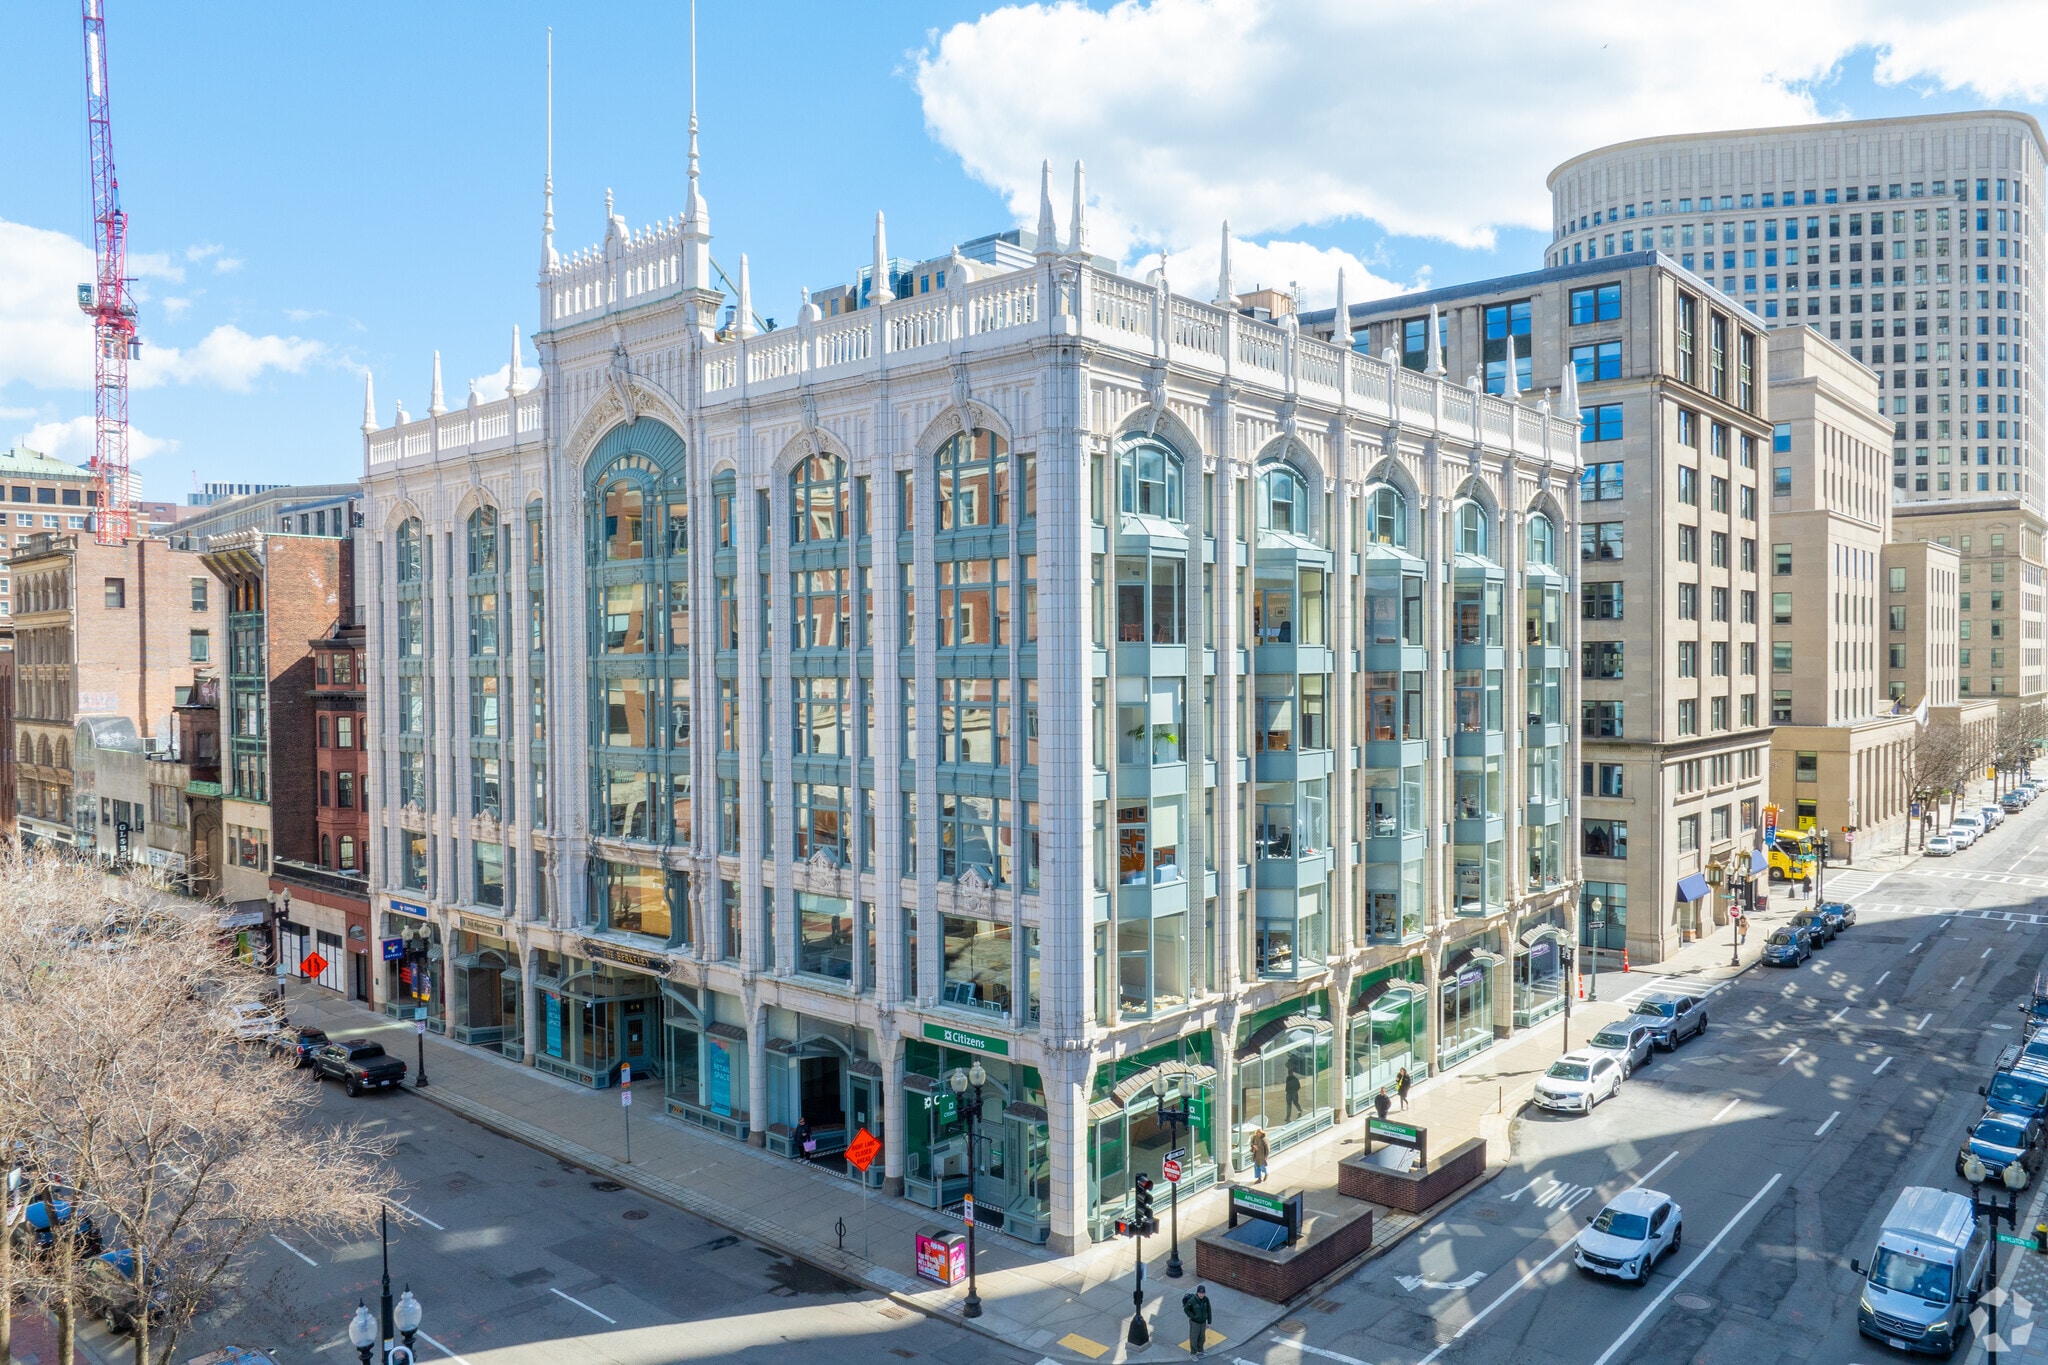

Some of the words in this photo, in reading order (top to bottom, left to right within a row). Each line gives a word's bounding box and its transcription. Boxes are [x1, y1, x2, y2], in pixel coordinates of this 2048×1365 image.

[602, 948, 614, 959] THE
[616, 951, 650, 967] BERKELEY
[952, 1032, 985, 1049] Citizens
[713, 1063, 730, 1074] RETAIL
[714, 1071, 730, 1081] SPACE
[1380, 1124, 1406, 1134] ARLINGTON
[864, 1140, 875, 1148] LANE
[855, 1148, 872, 1158] CLOSED
[856, 1156, 871, 1164] AHEAD
[1500, 1176, 1594, 1212] ONLY
[1244, 1195, 1272, 1207] ARLINGTON
[2000, 1235, 2025, 1245] BOYLSTON
